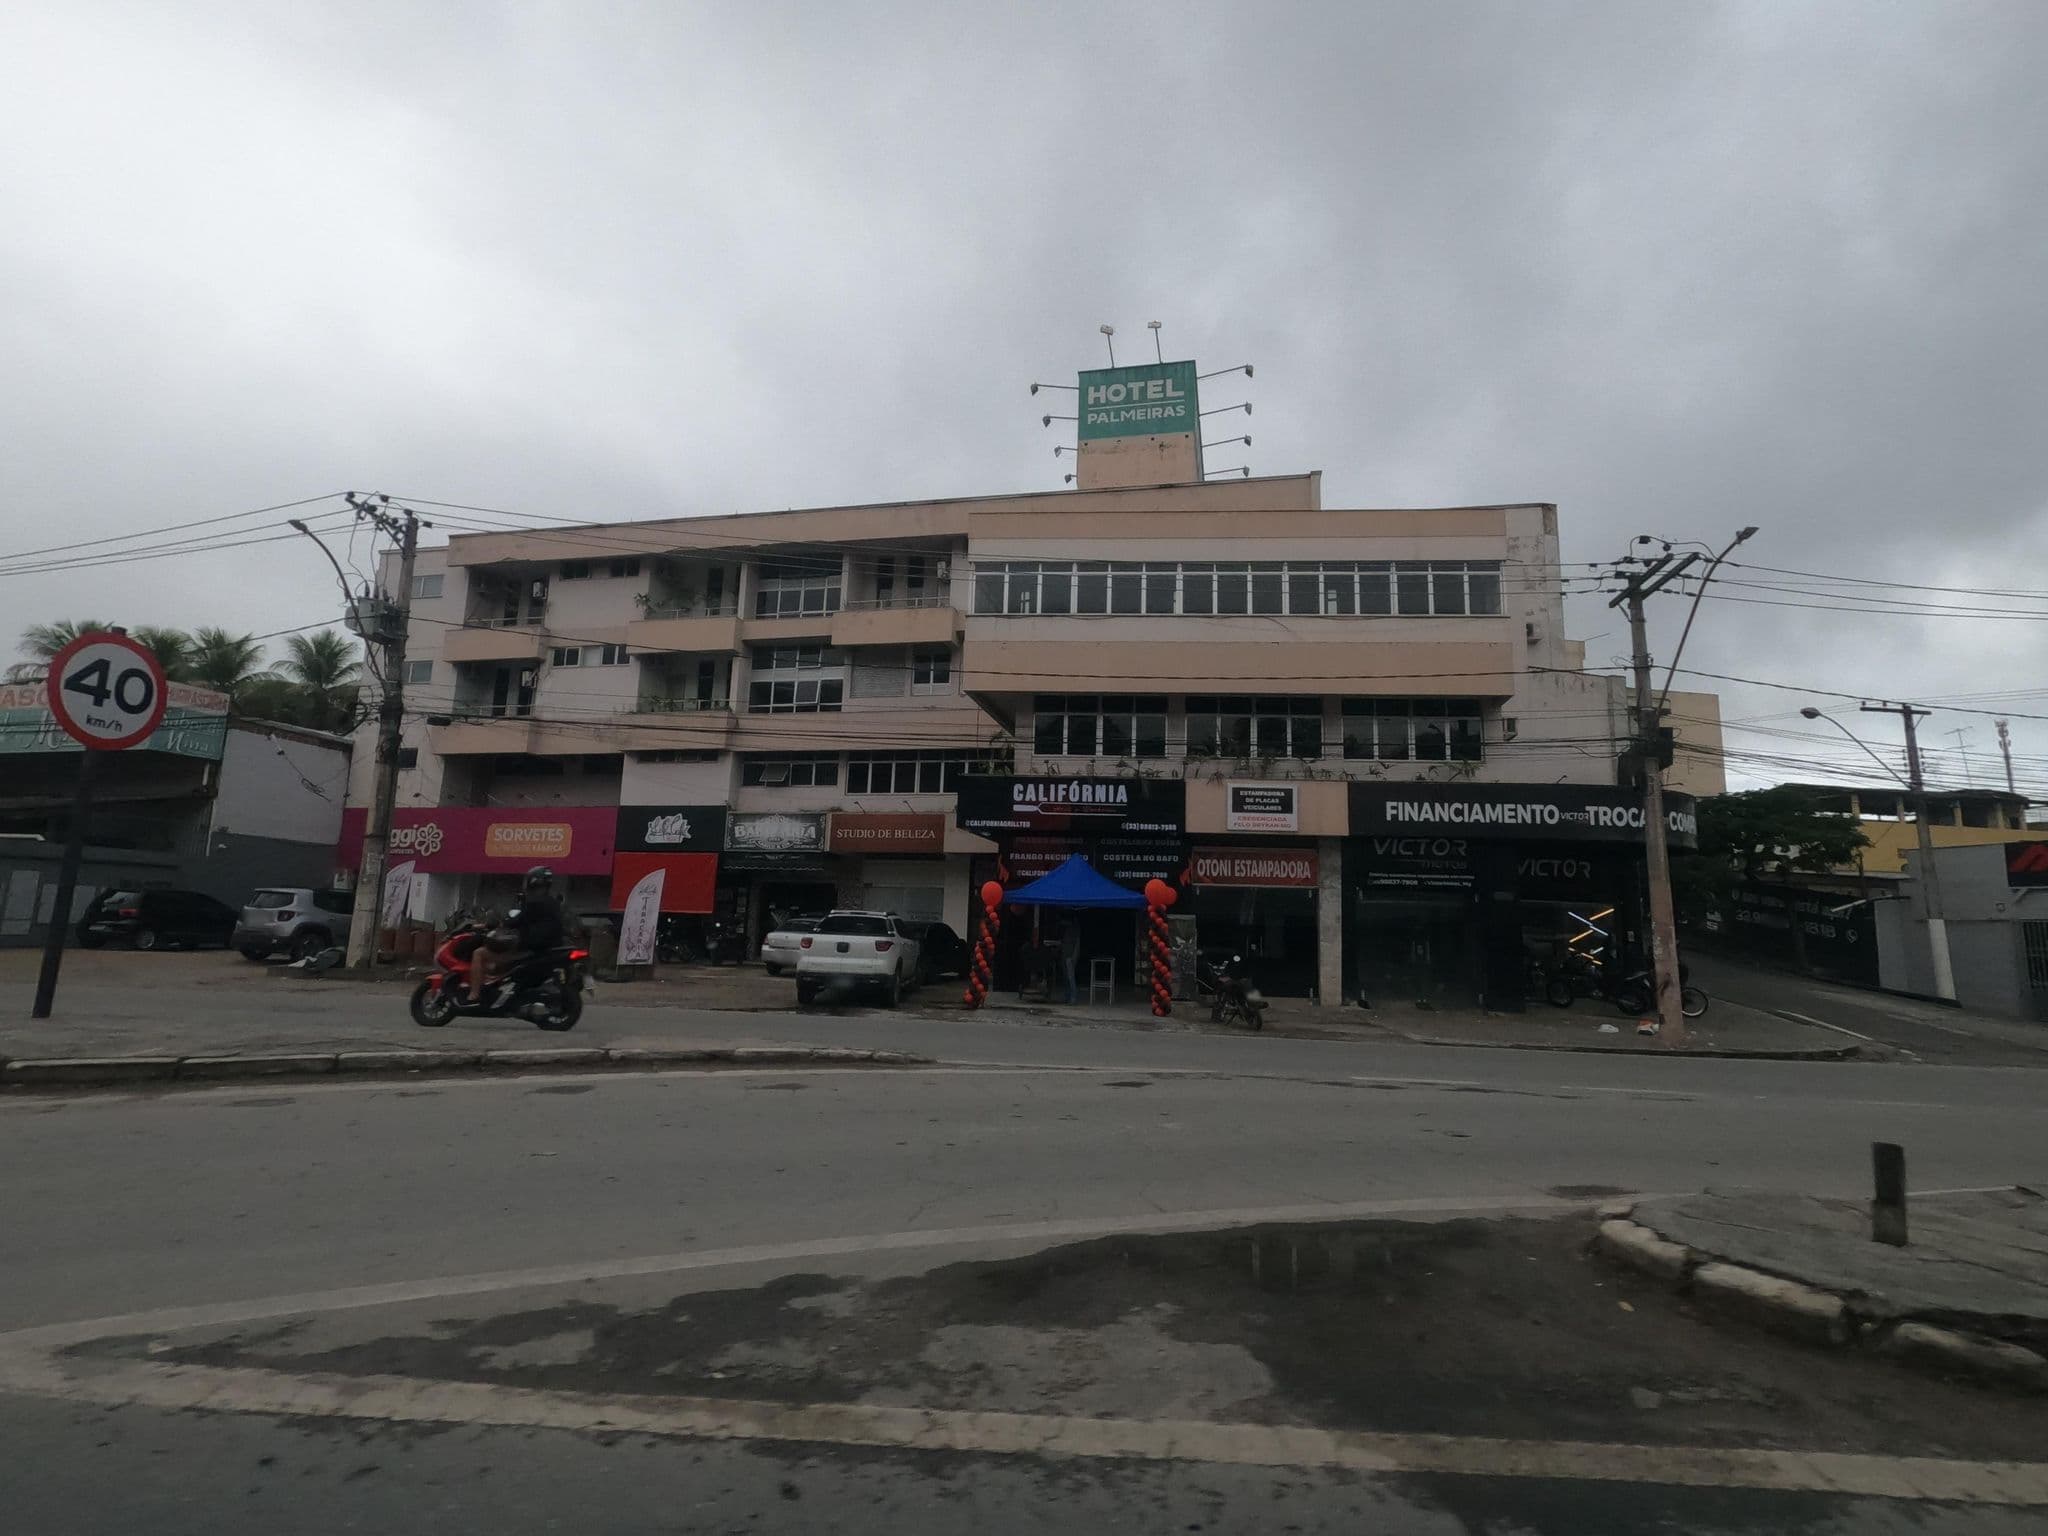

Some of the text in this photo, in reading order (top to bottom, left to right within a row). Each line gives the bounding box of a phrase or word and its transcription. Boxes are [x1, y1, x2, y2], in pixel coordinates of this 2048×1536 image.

[1087, 378, 1185, 405] HOTEL
[1087, 404, 1186, 425] PALMEIRAS
[63, 657, 154, 715] 40
[86, 714, 123, 732] km/h
[1013, 780, 1128, 803] CALIFÓRNIA
[1385, 800, 1560, 825] FINANCIAMENTO
[1560, 811, 1588, 821] VICTOR
[494, 828, 564, 842] SORVETES
[836, 828, 936, 840] STUDIO DE BELEZA
[1374, 838, 1467, 857] VICTOR
[1103, 854, 1179, 863] COSTELA NO BAFO
[1197, 858, 1311, 879] OTONI ESTAMPADORA
[1512, 858, 1591, 879] VICTOR
